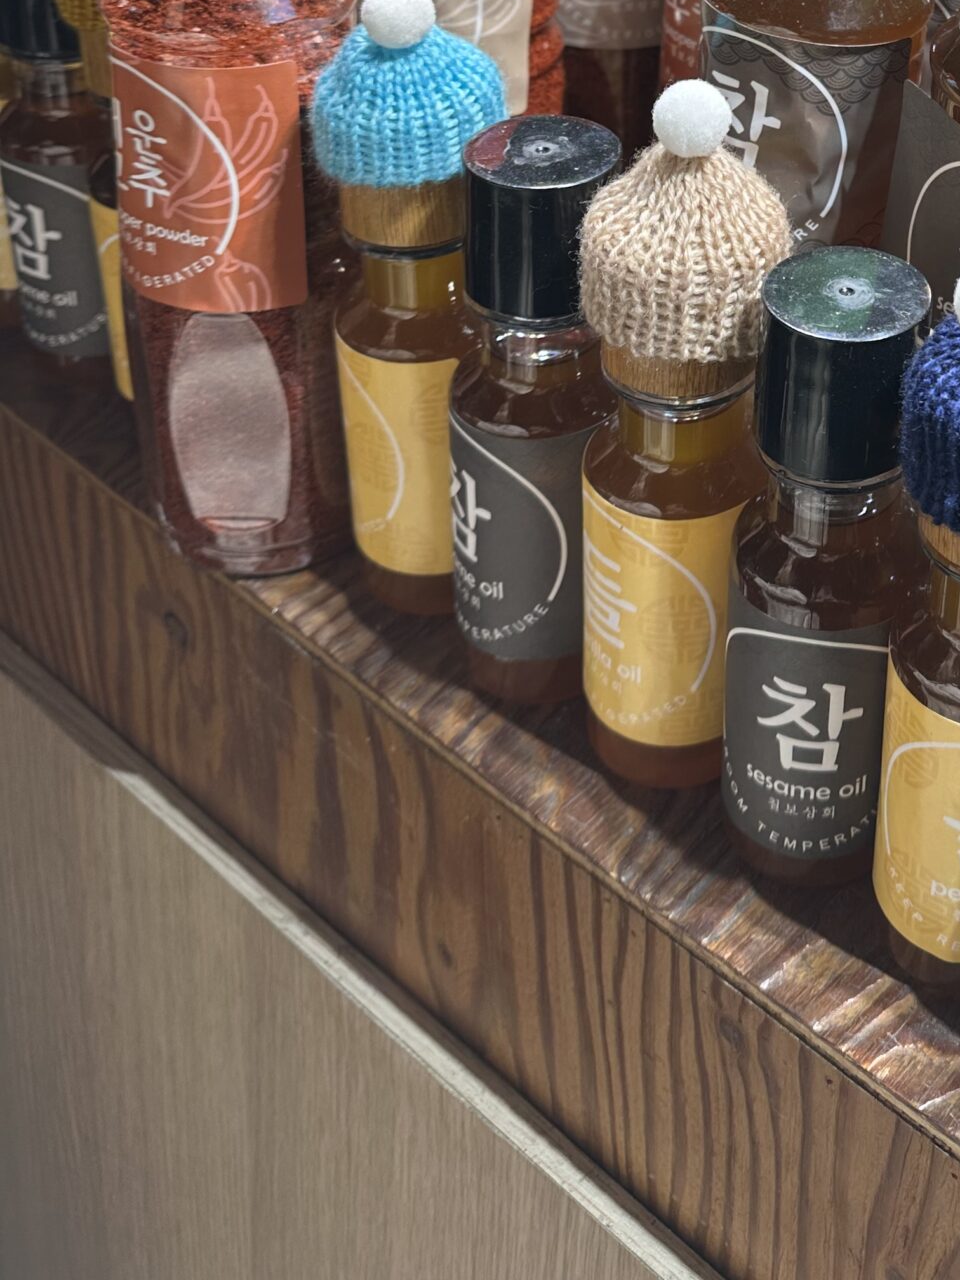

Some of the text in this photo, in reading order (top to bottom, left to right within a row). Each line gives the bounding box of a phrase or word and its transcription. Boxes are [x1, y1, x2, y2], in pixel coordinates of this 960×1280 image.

[6, 197, 63, 281] 참
[146, 221, 209, 247] powder
[479, 580, 504, 601] oil
[616, 664, 642, 685] oil
[757, 676, 864, 772] 참
[747, 763, 867, 800] sesame oil
